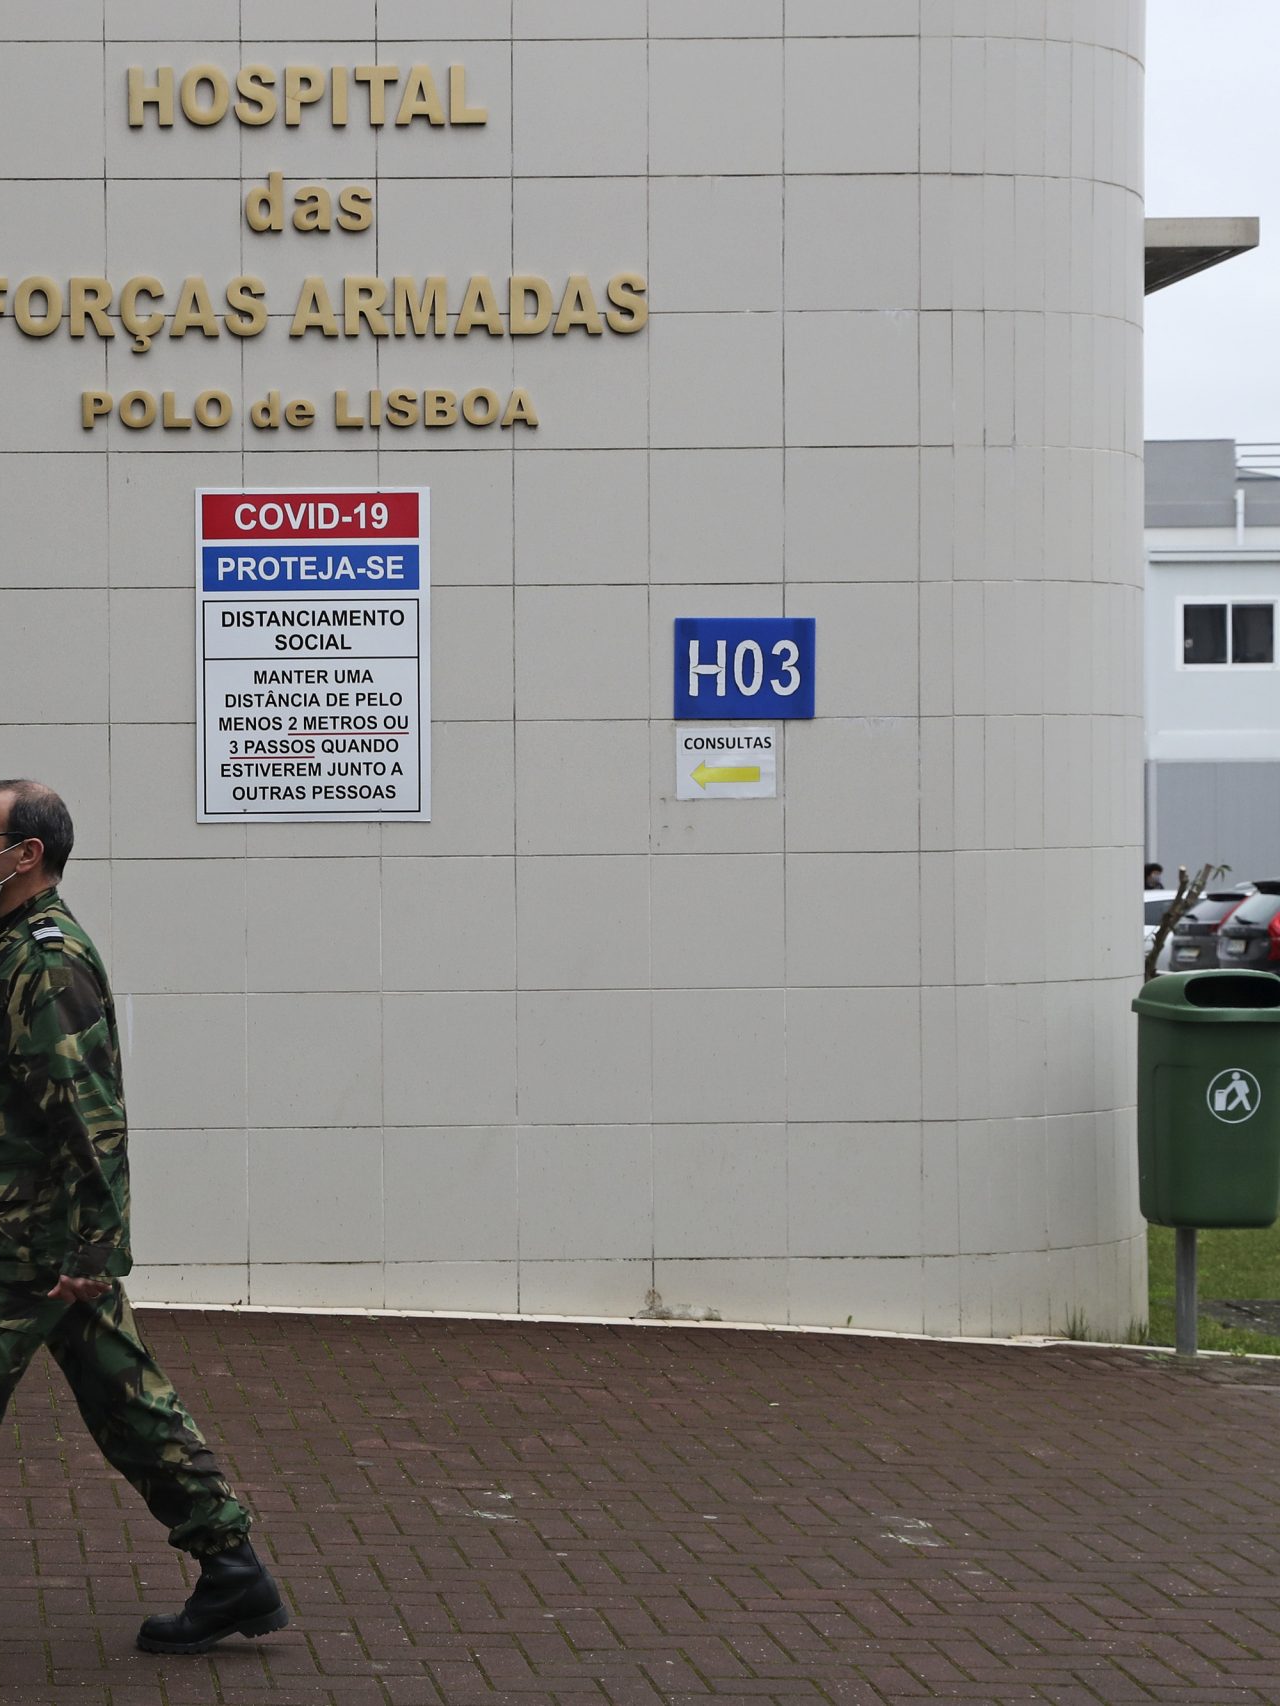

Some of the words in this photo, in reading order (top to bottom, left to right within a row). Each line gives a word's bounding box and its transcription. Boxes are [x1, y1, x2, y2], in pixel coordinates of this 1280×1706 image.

[128, 65, 488, 127] HOSPITAL
[245, 172, 373, 231] das
[289, 272, 649, 337] ARMADAS
[81, 389, 233, 429] POLO
[250, 390, 316, 428] de
[334, 387, 539, 428] LISBOA
[234, 502, 389, 530] COVID-19
[217, 555, 404, 581] PROTEJA-SE
[221, 609, 405, 628] DISTANCIAMENTO
[274, 633, 352, 651] SOCIAL
[253, 670, 328, 685] MANTER
[334, 669, 374, 684] UMA
[688, 639, 801, 697] H03
[224, 690, 320, 708] DISTÂNCIA
[325, 693, 350, 707] DE
[355, 692, 402, 707] PELO
[218, 716, 283, 732] MENOS
[288, 716, 297, 730] 2
[303, 715, 378, 731] METROS
[383, 715, 409, 730] OU
[229, 741, 239, 755] 3
[244, 739, 316, 755] PASSOS
[321, 739, 399, 755] QUANDO
[684, 736, 772, 750] CONSULTAS
[220, 763, 321, 778] ESTIVEREM
[327, 762, 387, 777] JUNTO
[391, 762, 403, 776] A
[232, 786, 306, 801] OUTRAS
[312, 785, 396, 800] PESSOAS
